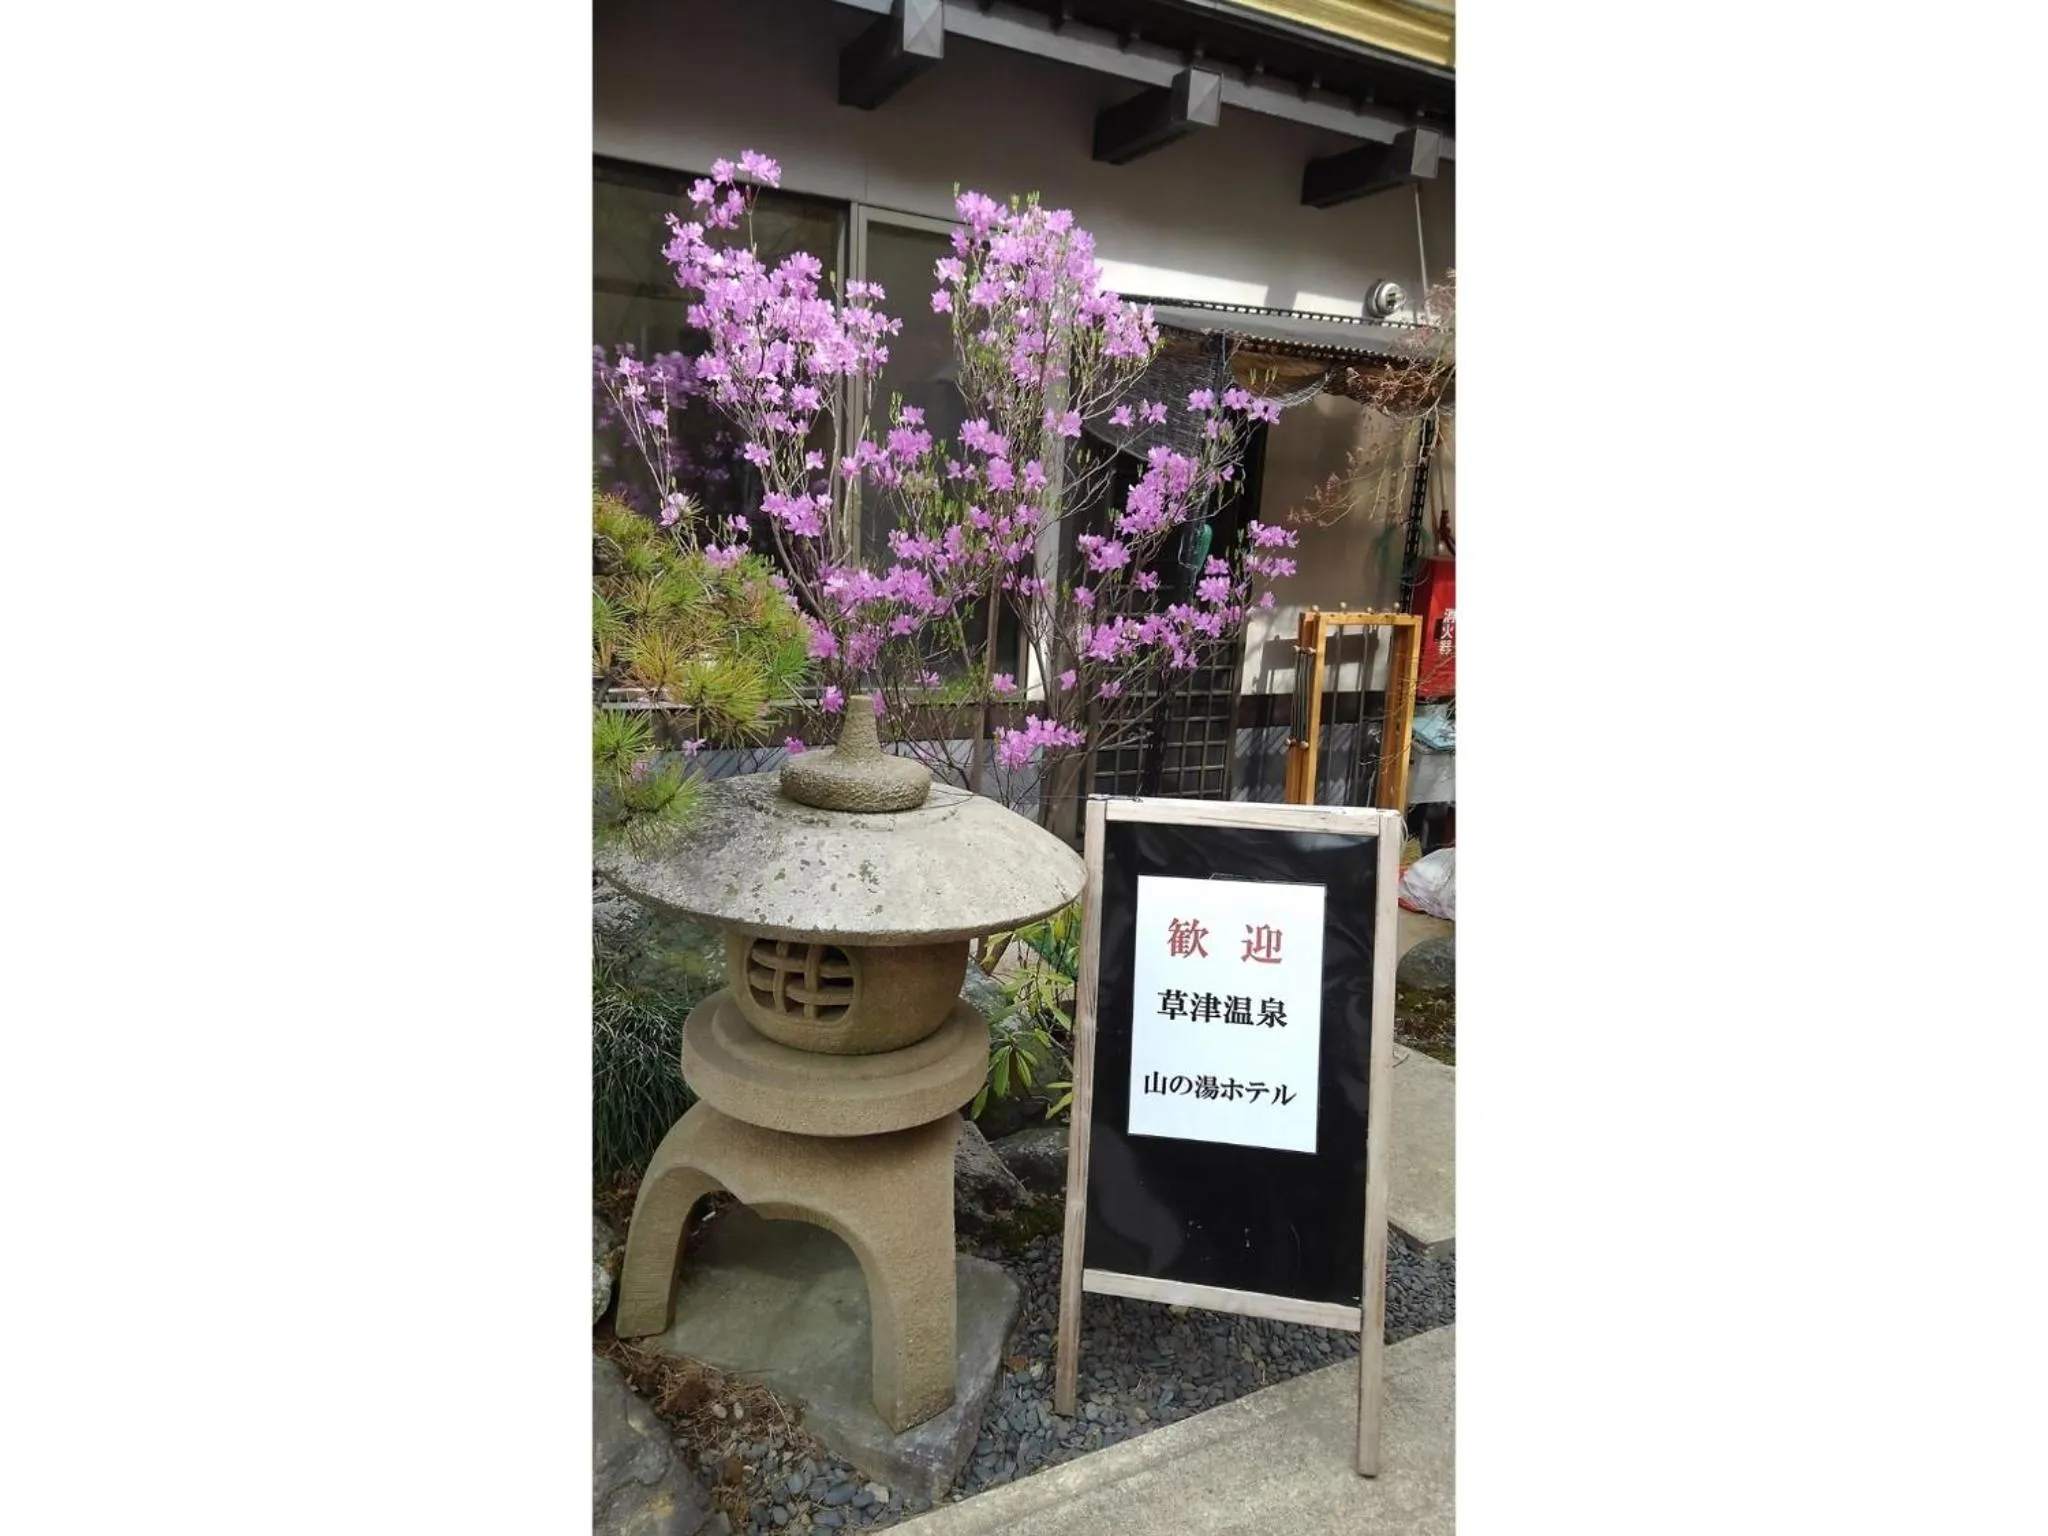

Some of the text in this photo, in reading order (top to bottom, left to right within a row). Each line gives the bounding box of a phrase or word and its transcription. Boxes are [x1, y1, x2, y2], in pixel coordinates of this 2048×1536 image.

[1156, 988, 1288, 1029] 草津温泉
[1144, 1070, 1297, 1106] 山の湯ホテル
